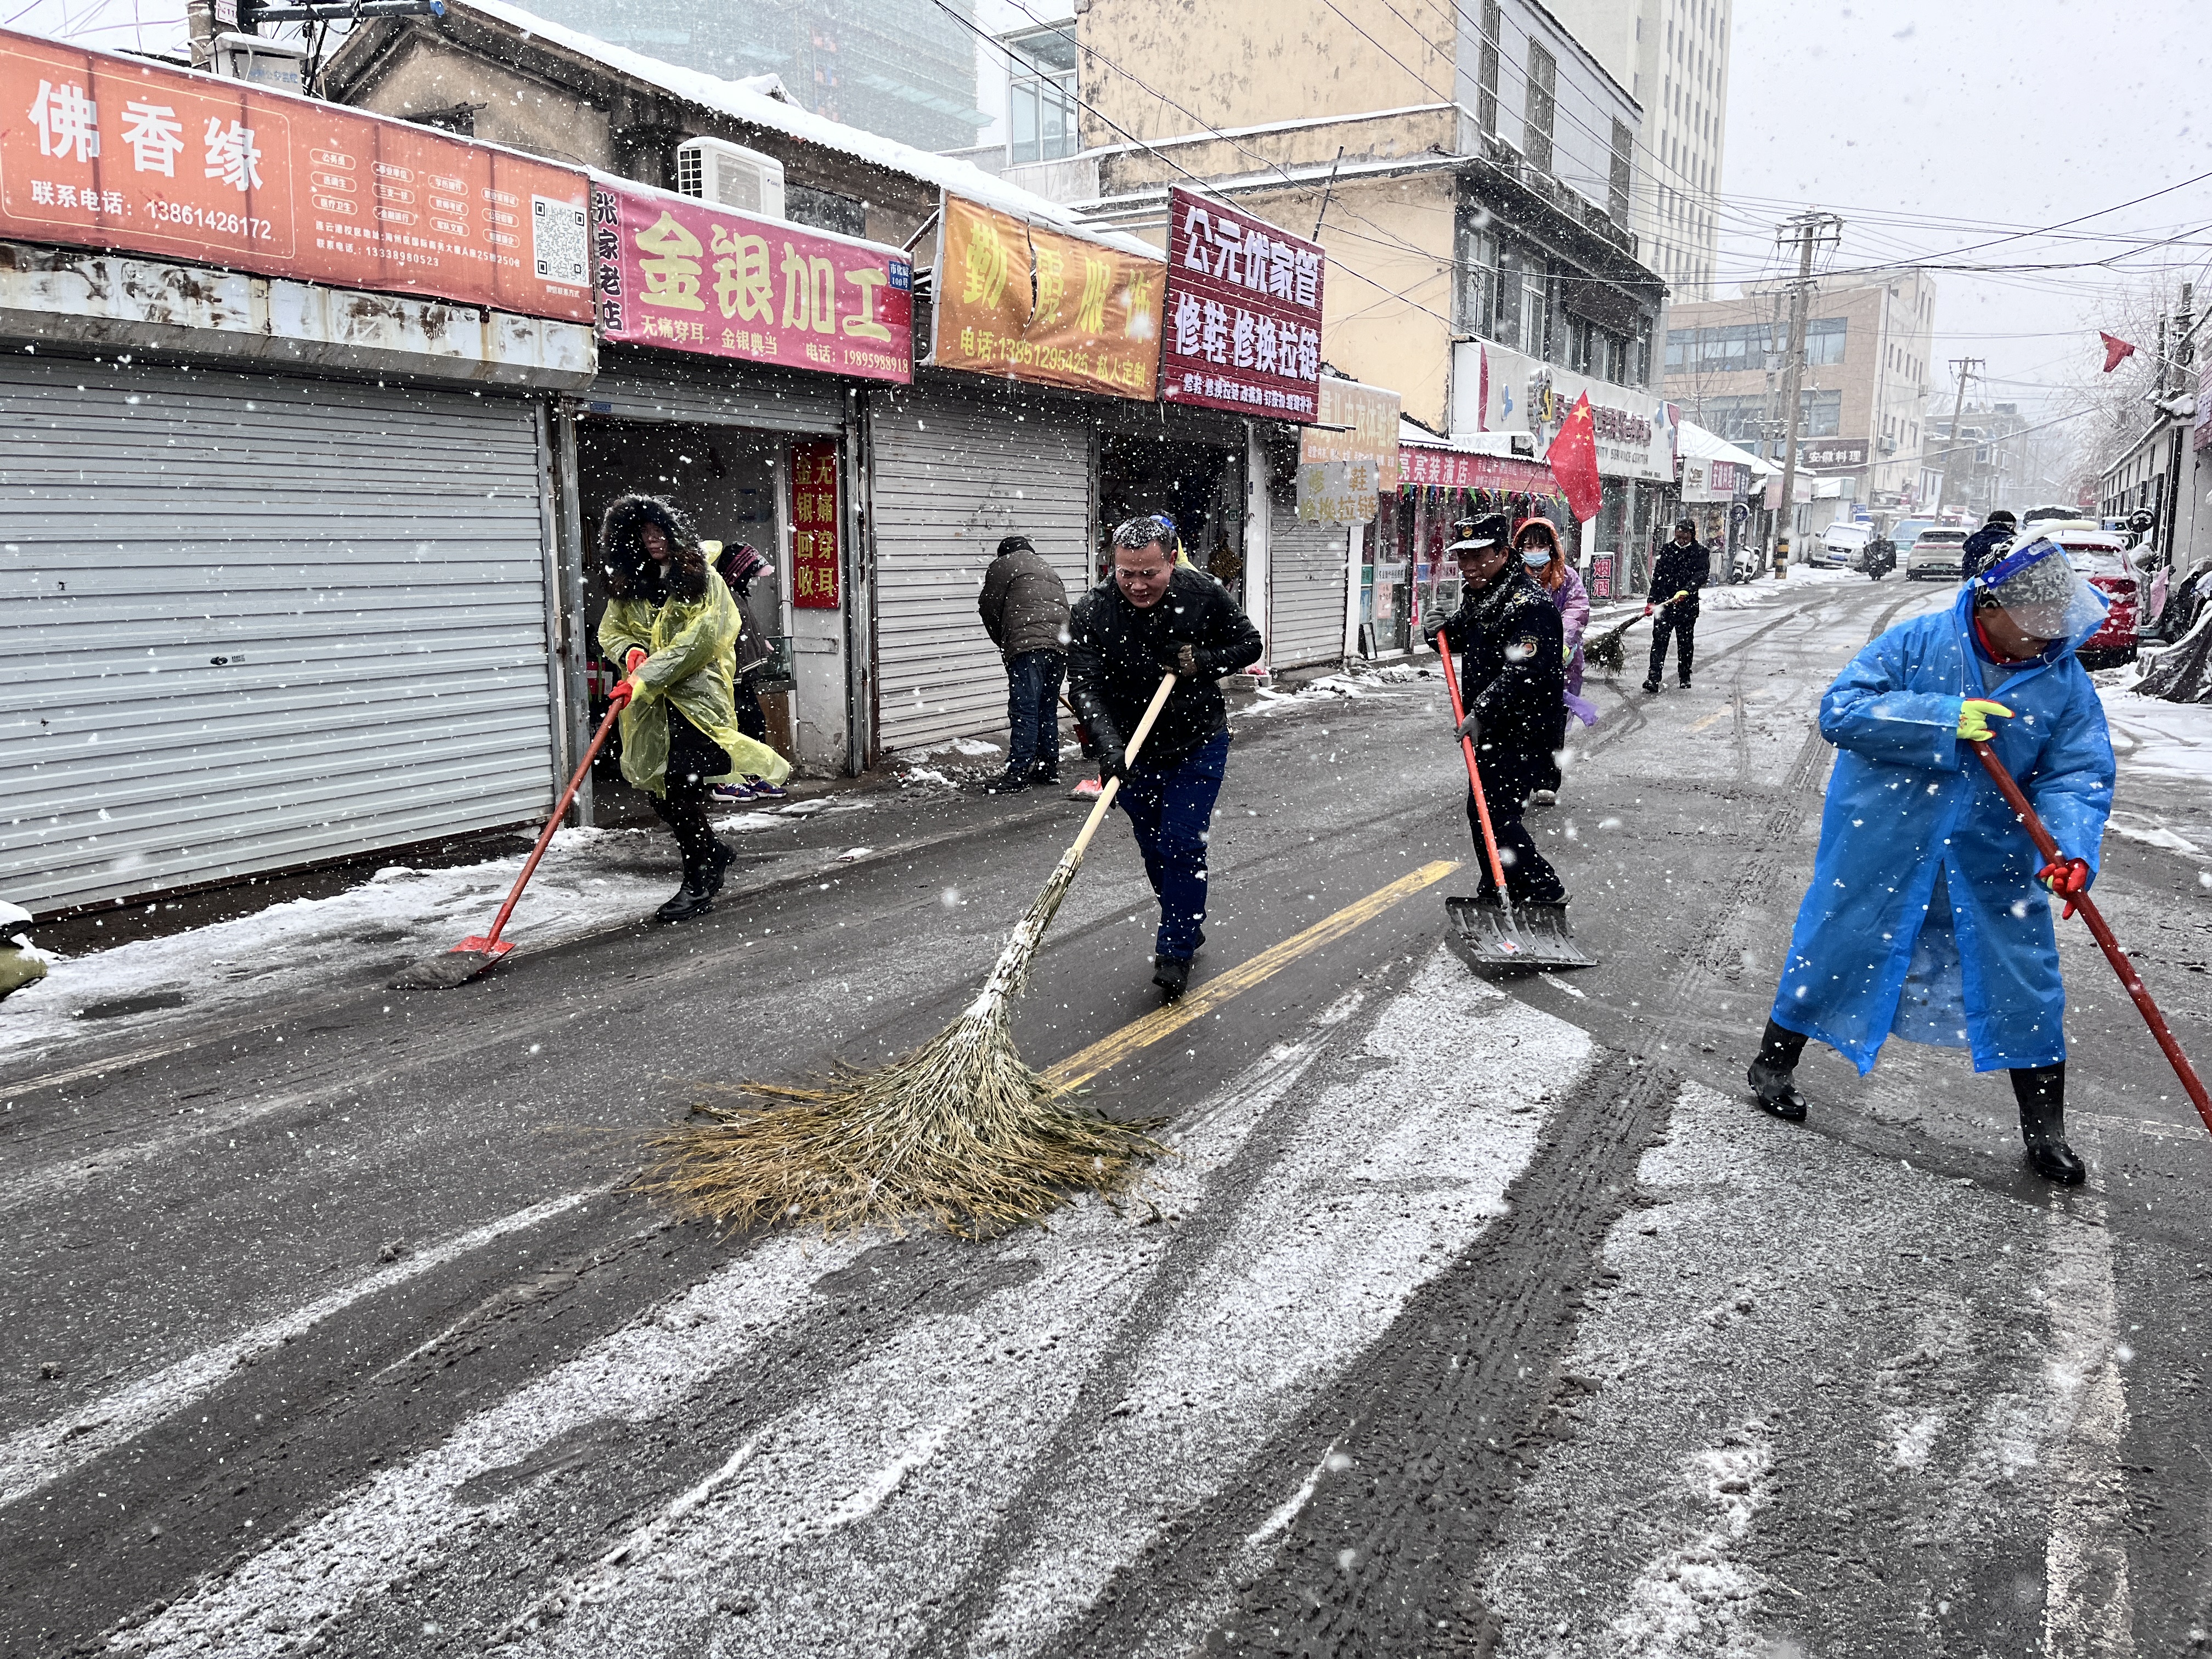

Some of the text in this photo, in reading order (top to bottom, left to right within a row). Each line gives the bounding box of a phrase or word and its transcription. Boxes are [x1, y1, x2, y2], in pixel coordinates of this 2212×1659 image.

[28, 79, 263, 191] 佛香缘
[322, 153, 345, 166] 公务员
[380, 185, 408, 200] 三支一扶
[596, 192, 623, 331] 张家老店
[635, 210, 891, 342] 金银加工
[1184, 205, 1318, 308] 公元优家管
[963, 219, 1152, 344] 勤霞服饰
[640, 314, 704, 345] 无痛穿耳
[721, 328, 777, 356] 金银典当
[1175, 291, 1318, 381] 修鞋 修换拉链
[1096, 355, 1146, 387] 私人定制
[1183, 373, 1202, 394] 修鞋
[1398, 451, 1469, 484] 亮亮装潢店
[1300, 495, 1377, 521] 修换拉链
[1593, 559, 1611, 596] 烟酒
